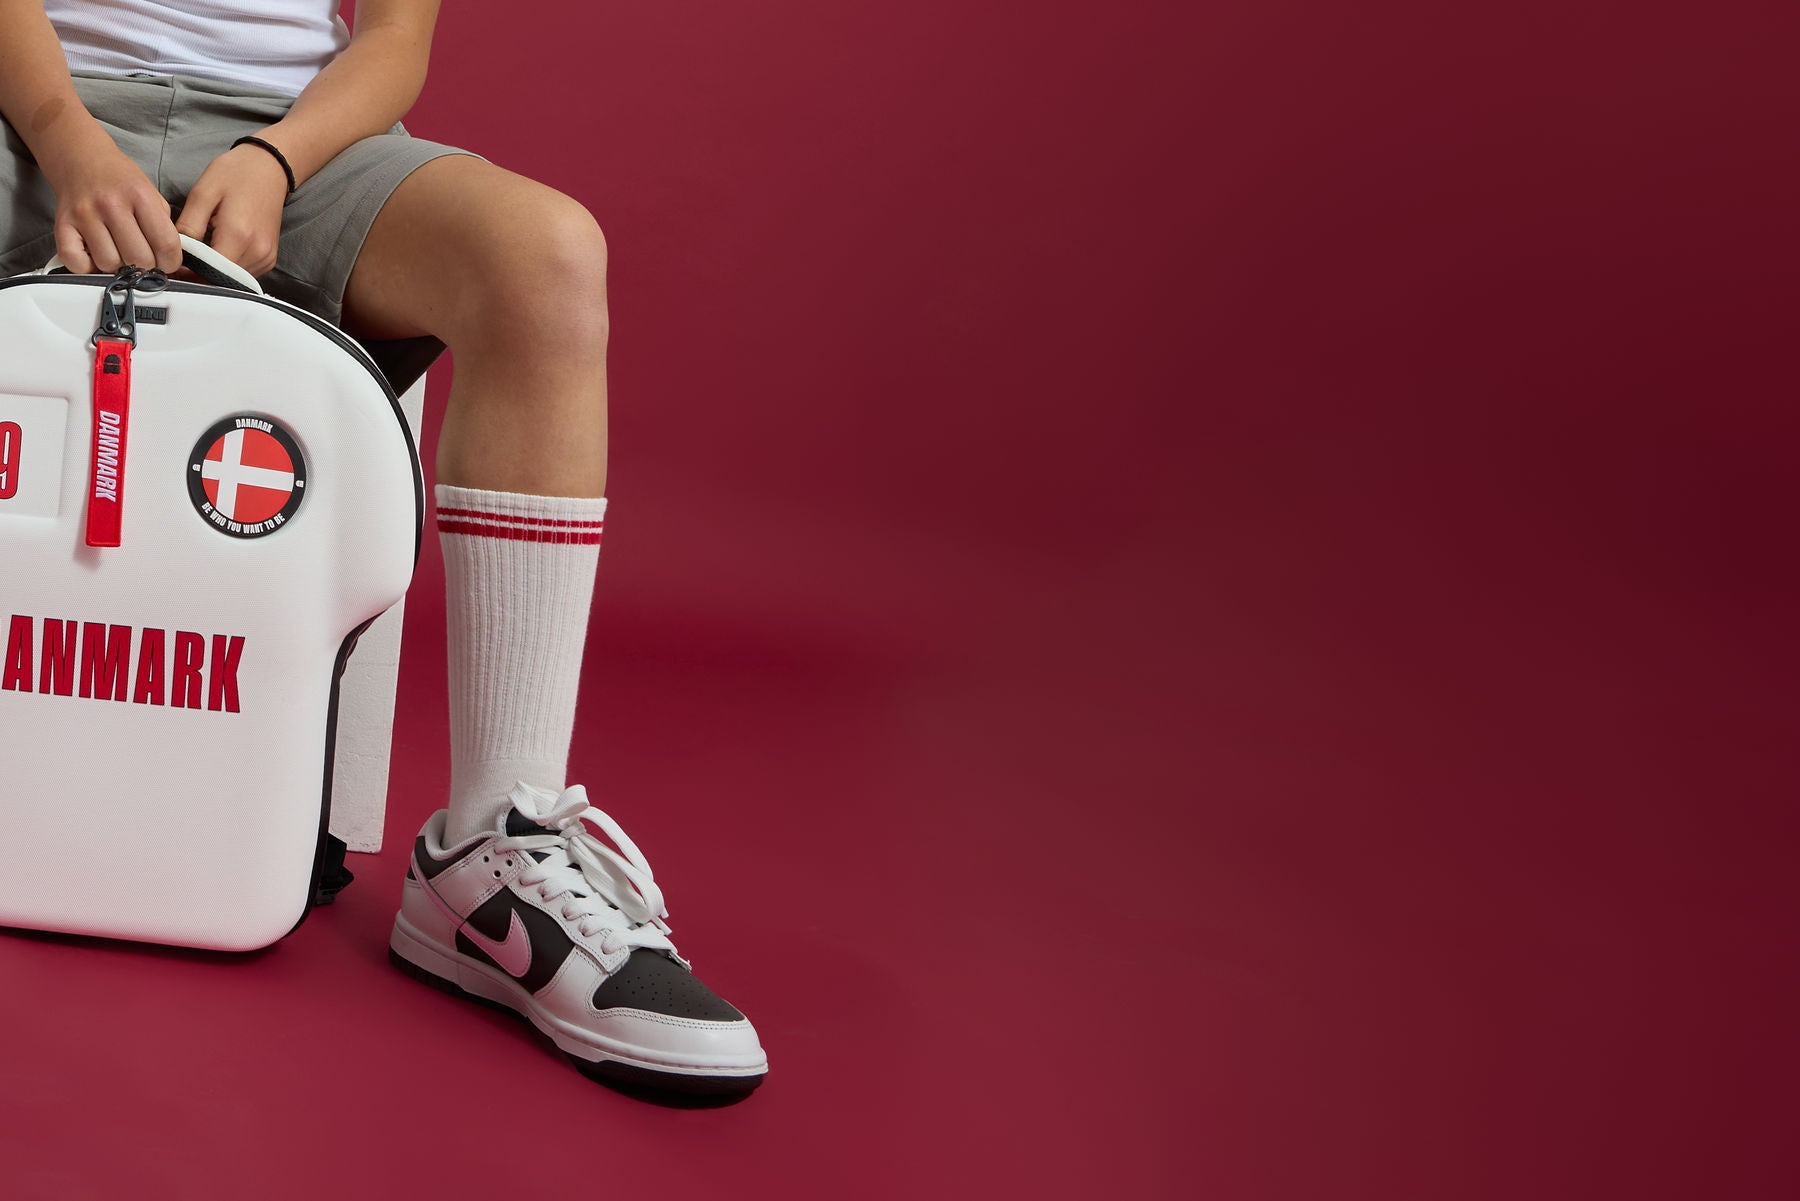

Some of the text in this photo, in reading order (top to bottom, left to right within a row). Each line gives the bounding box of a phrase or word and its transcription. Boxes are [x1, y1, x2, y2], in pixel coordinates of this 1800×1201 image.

[235, 418, 273, 433] DANMARK
[95, 410, 121, 503] DANMARK
[201, 501, 285, 534] BE WHO YOU WANT TO BE
